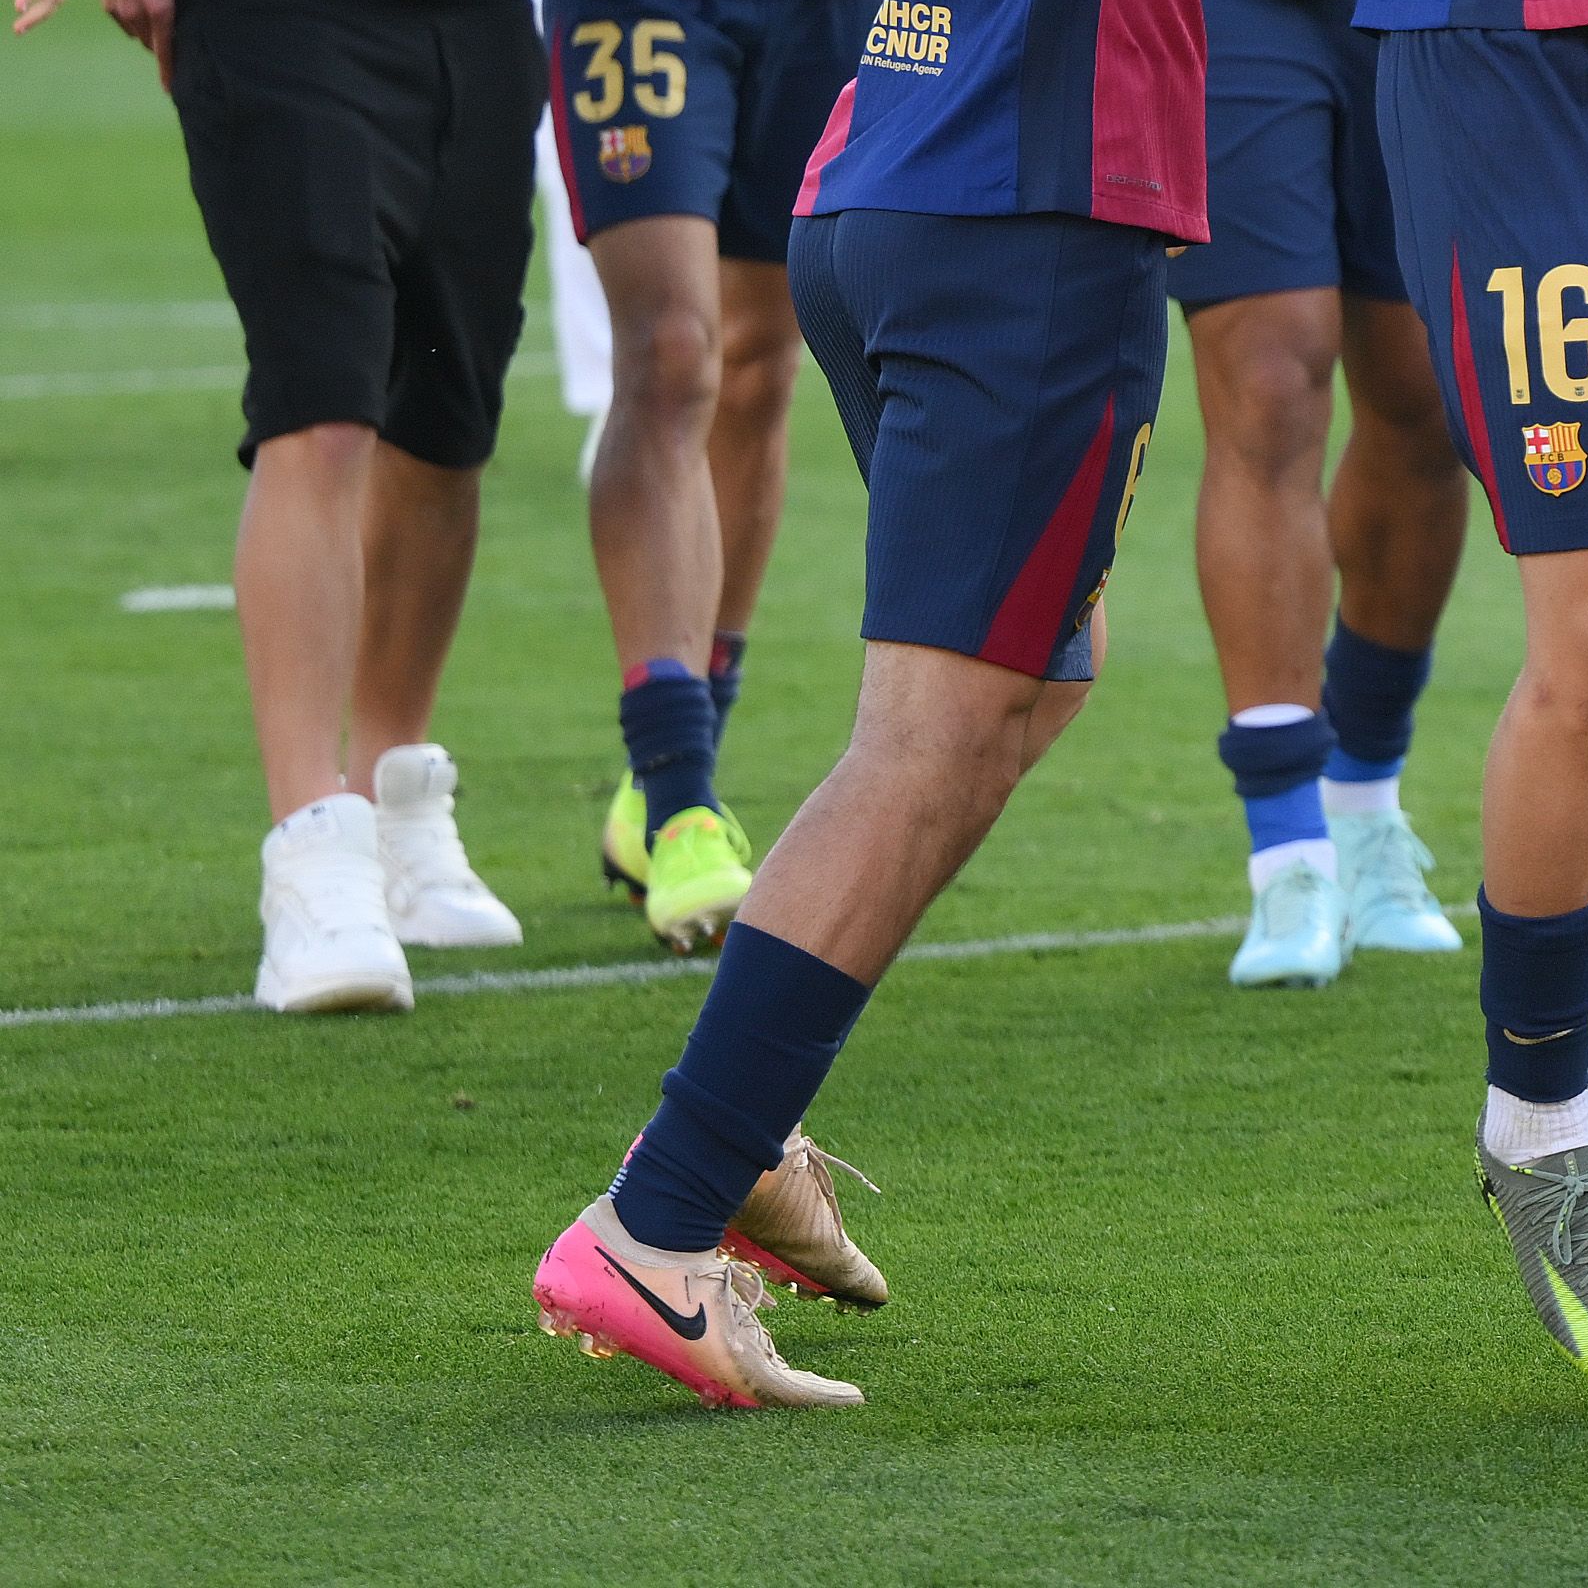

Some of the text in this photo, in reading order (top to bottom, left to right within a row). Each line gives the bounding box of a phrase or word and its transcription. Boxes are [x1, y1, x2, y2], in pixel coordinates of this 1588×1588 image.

[572, 18, 687, 123] 35
[874, 57, 912, 72] Refugee
[911, 63, 944, 77] Agency
[1540, 452, 1565, 462] FCB
